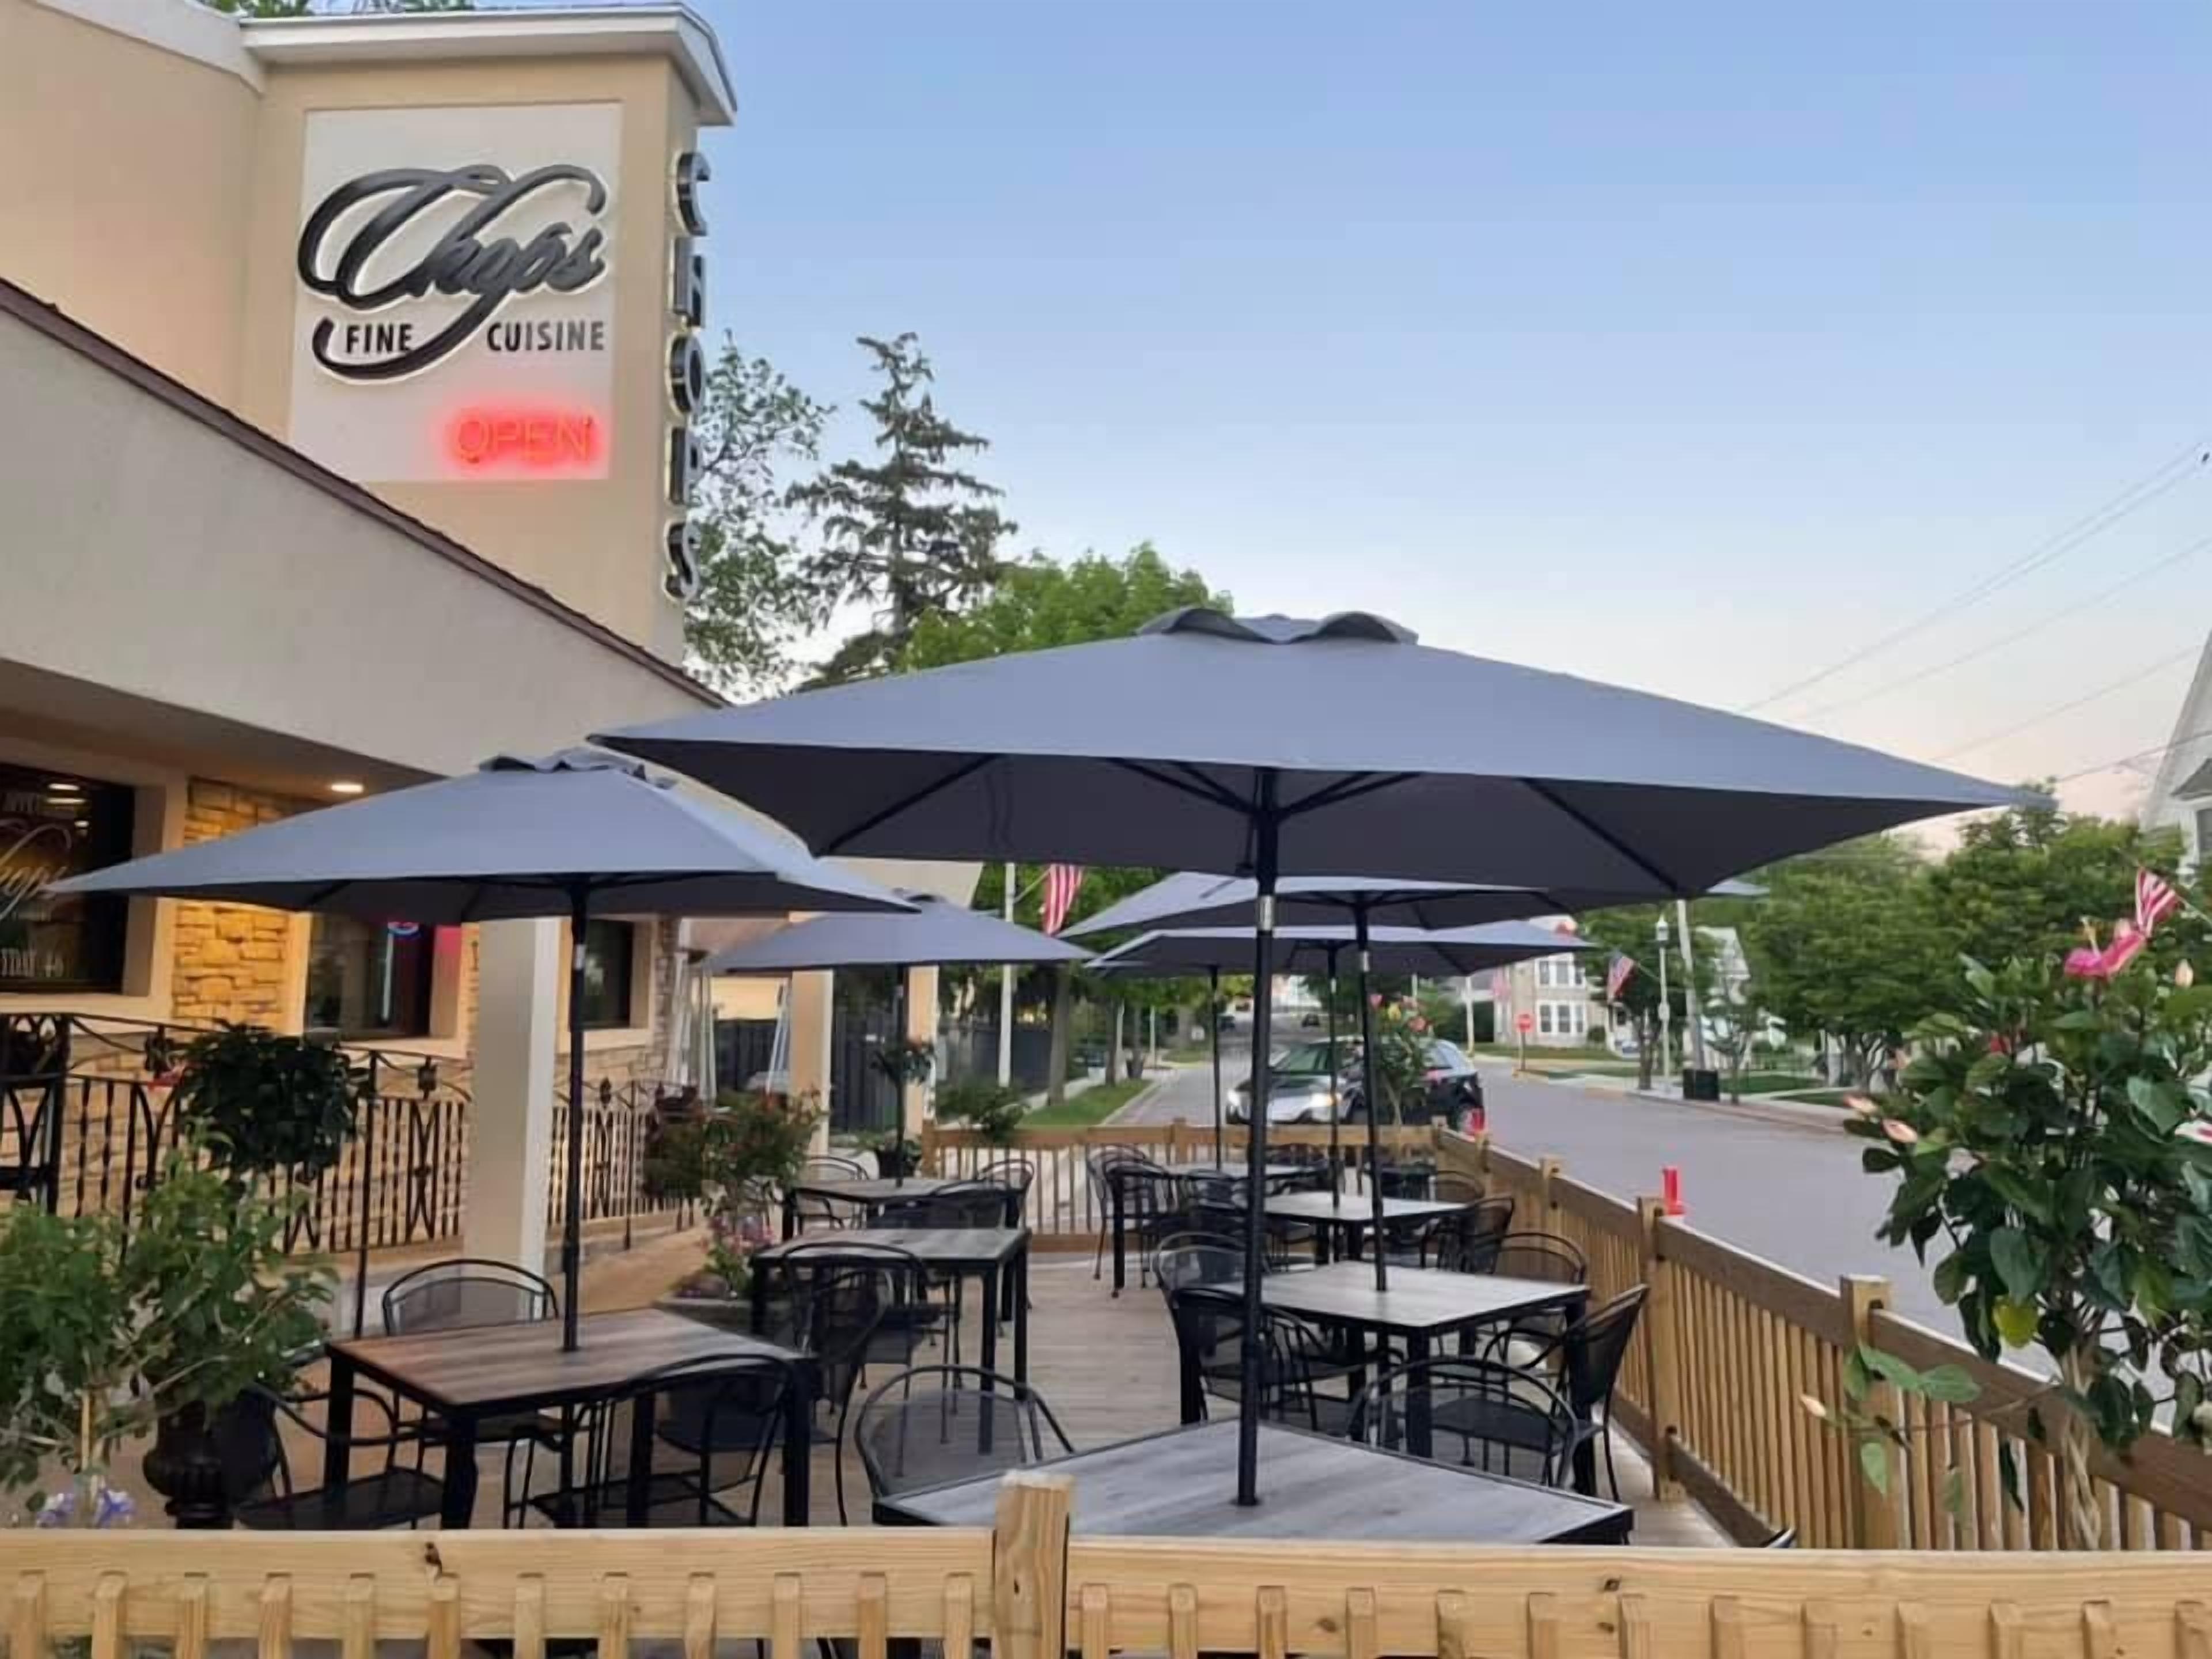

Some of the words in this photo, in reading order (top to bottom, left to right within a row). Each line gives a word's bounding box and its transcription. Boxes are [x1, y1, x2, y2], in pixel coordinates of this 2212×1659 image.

[297, 164, 607, 378] Chops
[345, 323, 414, 354] FINE
[486, 320, 605, 353] CUISINE
[665, 151, 710, 603] CHOPS
[457, 415, 593, 464] OPEN
